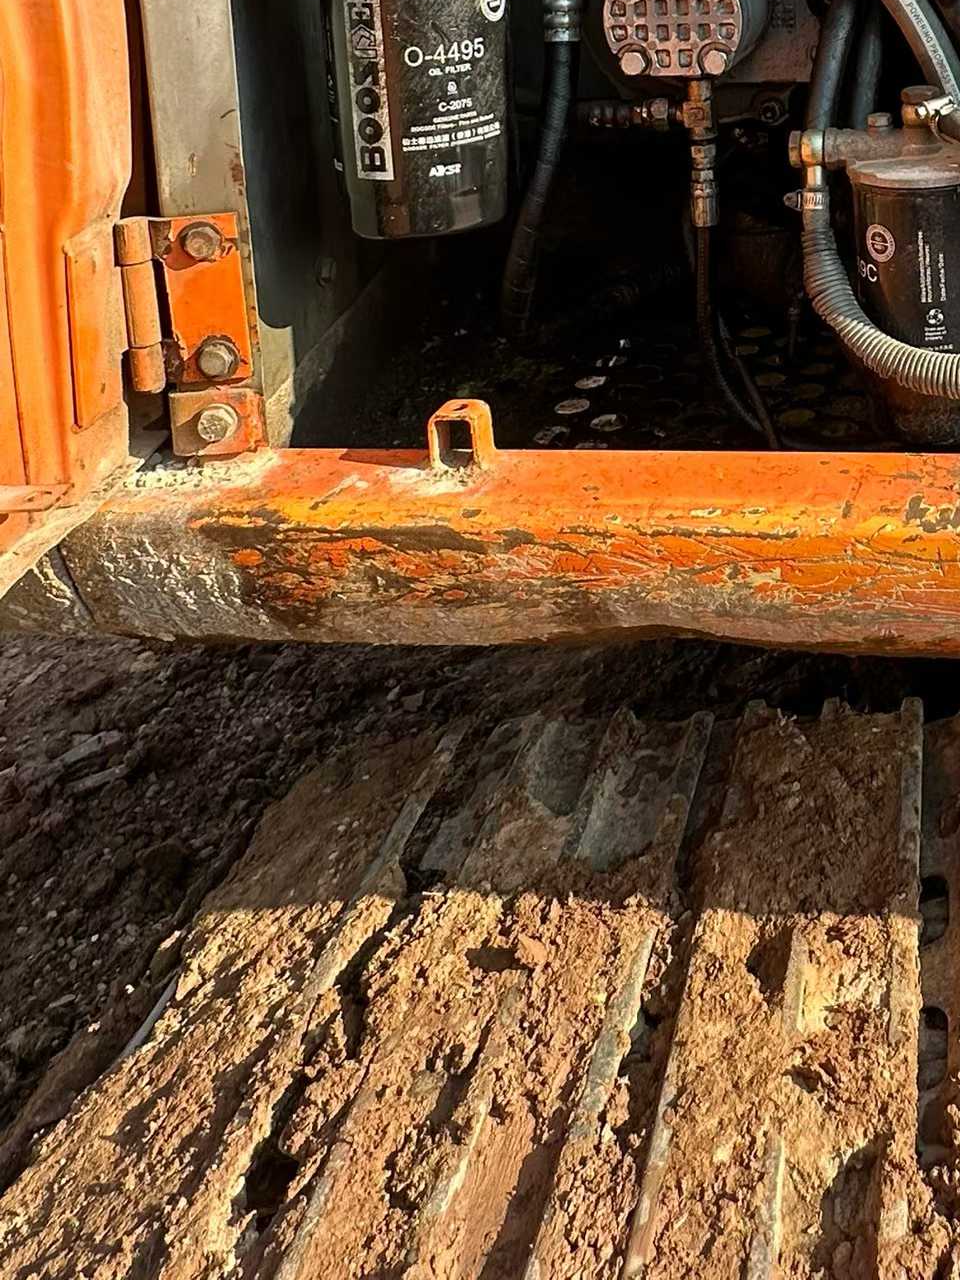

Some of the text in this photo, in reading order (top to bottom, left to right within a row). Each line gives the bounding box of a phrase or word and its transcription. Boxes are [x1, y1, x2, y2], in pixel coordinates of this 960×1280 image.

[905, 1, 934, 44] POWERING
[404, 37, 485, 67] O-4495
[445, 63, 472, 74] FILTER
[438, 97, 472, 112] C-2075
